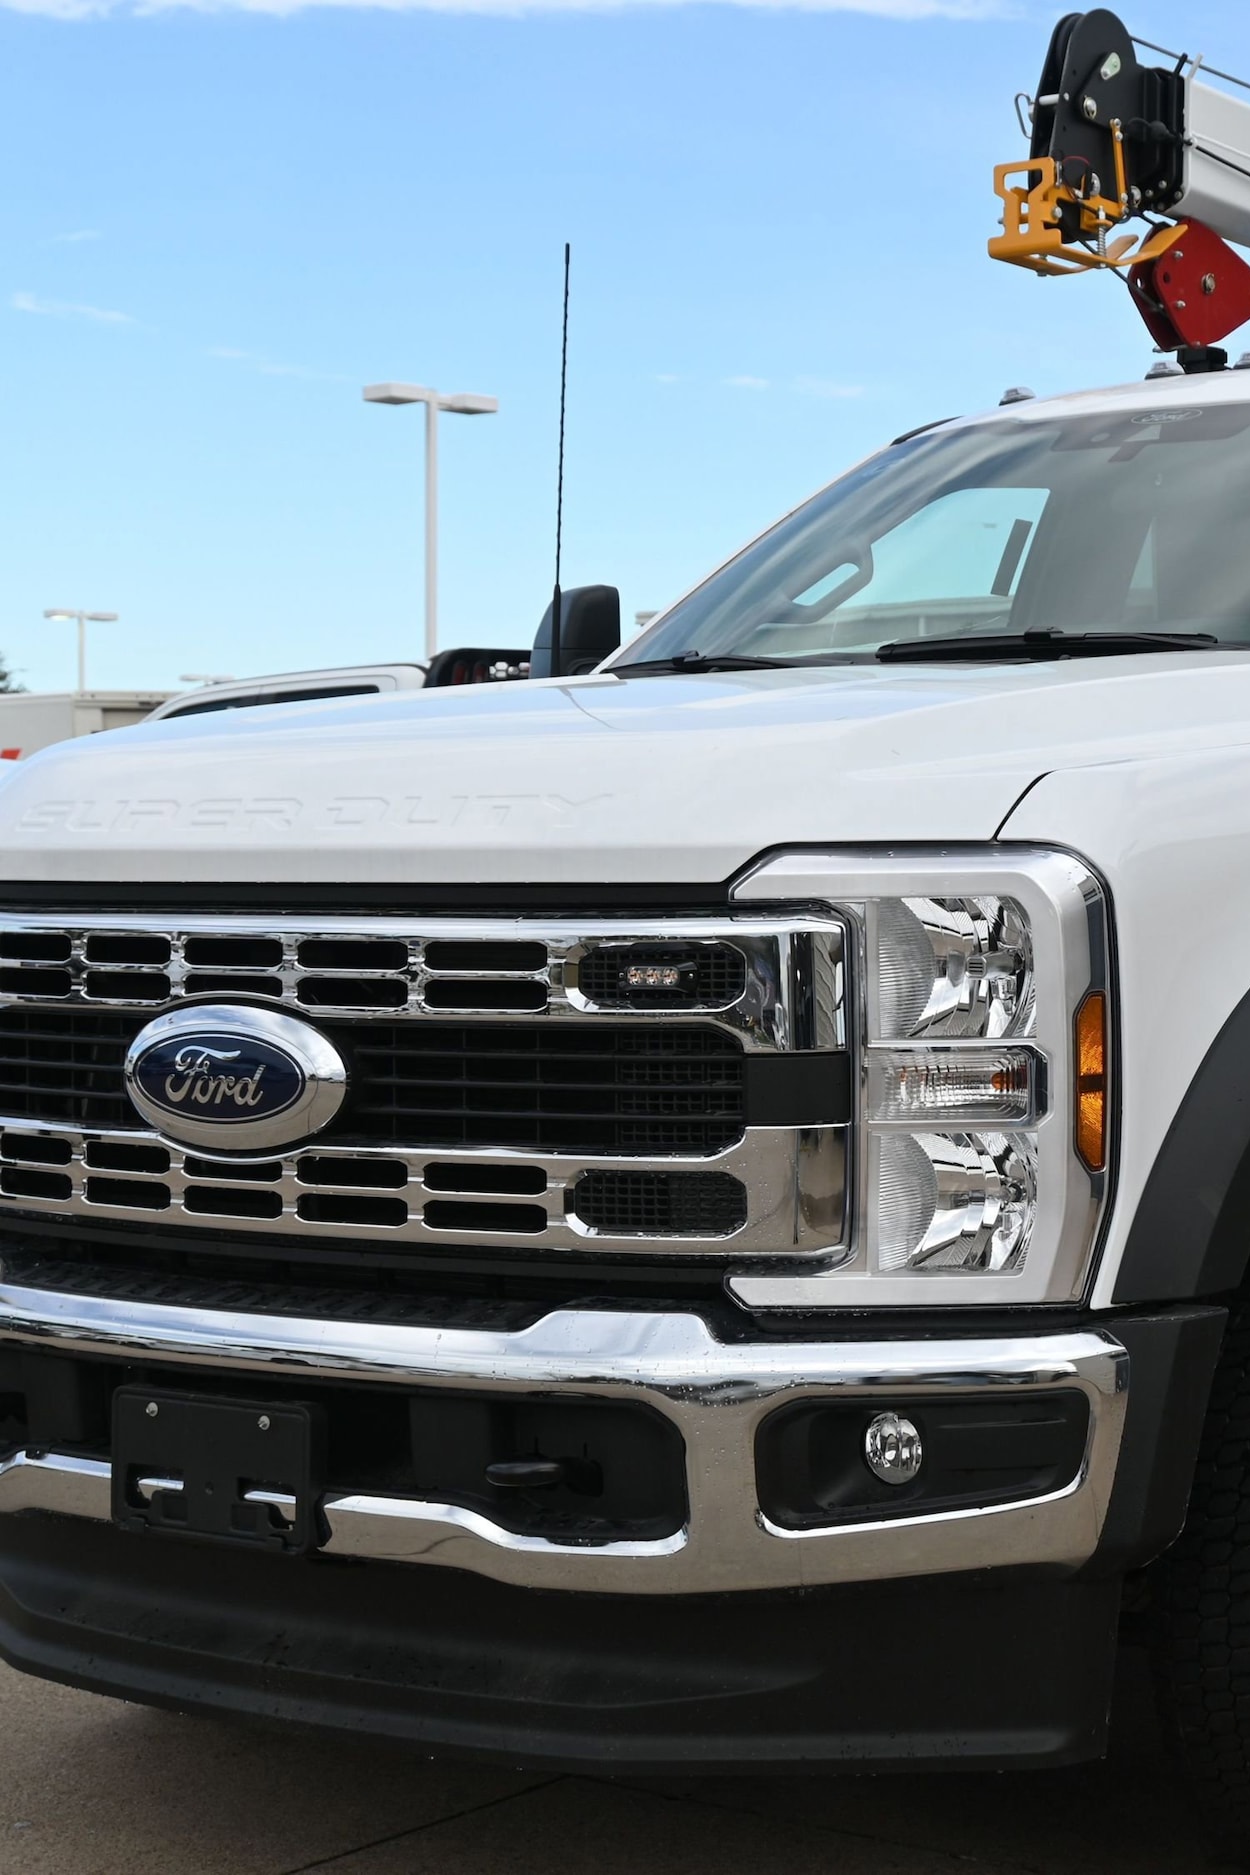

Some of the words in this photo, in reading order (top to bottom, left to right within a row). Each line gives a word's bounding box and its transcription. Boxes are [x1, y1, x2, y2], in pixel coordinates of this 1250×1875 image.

[14, 797, 304, 833] SUPER
[314, 792, 614, 833] DUTY
[165, 1045, 267, 1107] Ford
